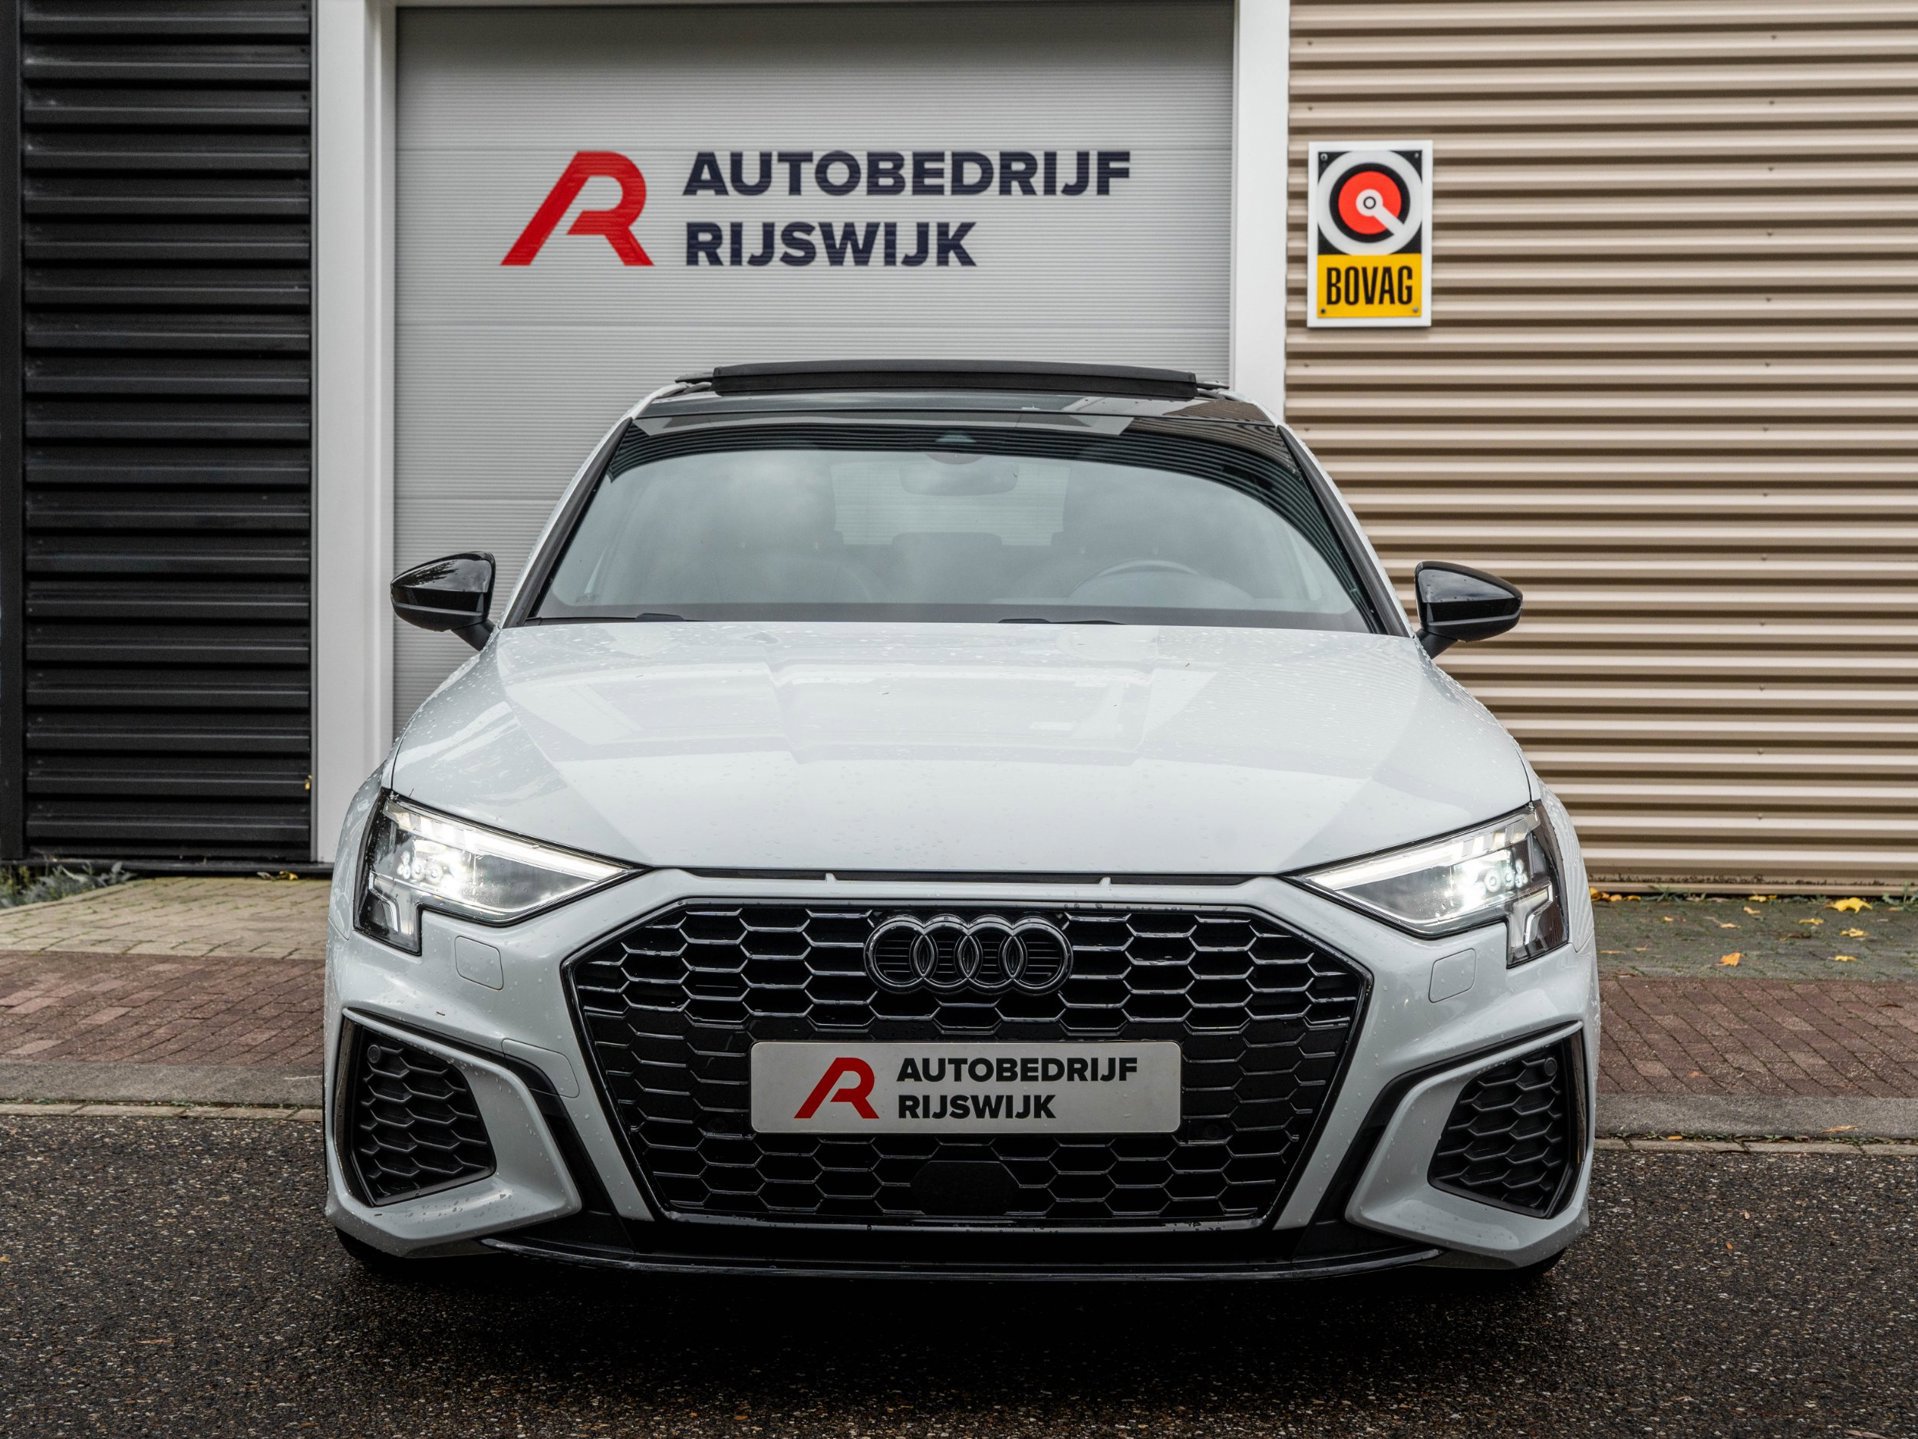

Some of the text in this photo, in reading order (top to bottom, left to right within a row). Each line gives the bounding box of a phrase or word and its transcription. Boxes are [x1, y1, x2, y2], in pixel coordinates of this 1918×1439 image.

[682, 150, 1131, 197] AUTOBEDRIJF
[686, 221, 977, 267] RIJSWIJK
[1326, 265, 1413, 306] BOVAG
[896, 1057, 1138, 1082] AUTOBEDRIJF
[899, 1094, 1056, 1119] RIJSWIJK
